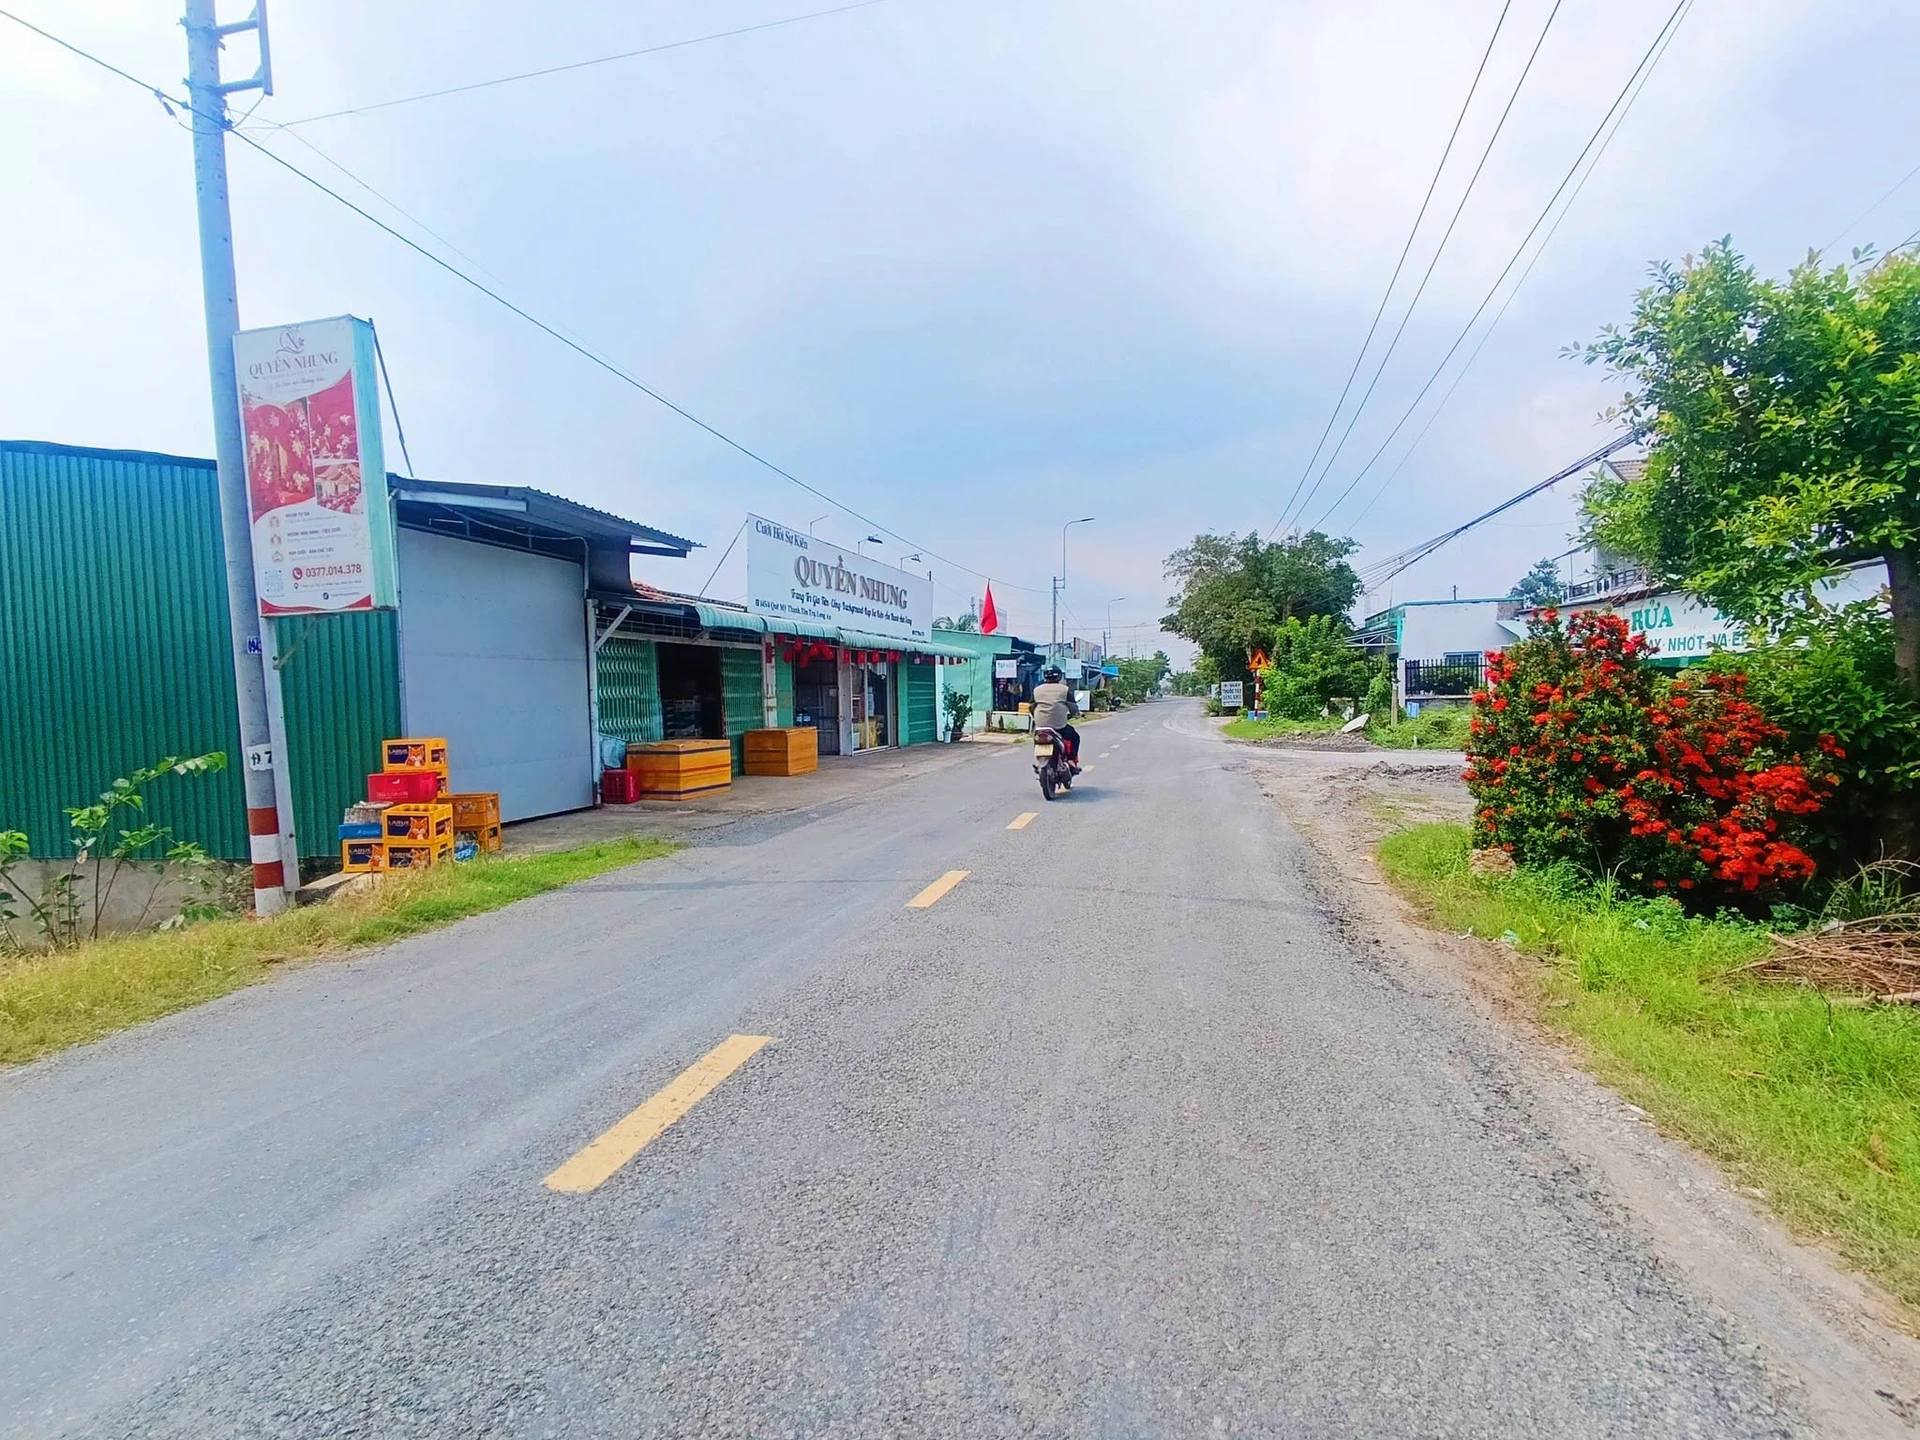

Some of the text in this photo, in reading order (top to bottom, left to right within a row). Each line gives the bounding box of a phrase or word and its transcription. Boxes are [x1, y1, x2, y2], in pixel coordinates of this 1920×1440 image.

[295, 351, 338, 369] NHUNG
[305, 563, 362, 578] 0377.014.378
[860, 575, 908, 610] NHUNG
[1631, 599, 1674, 632] RỬA
